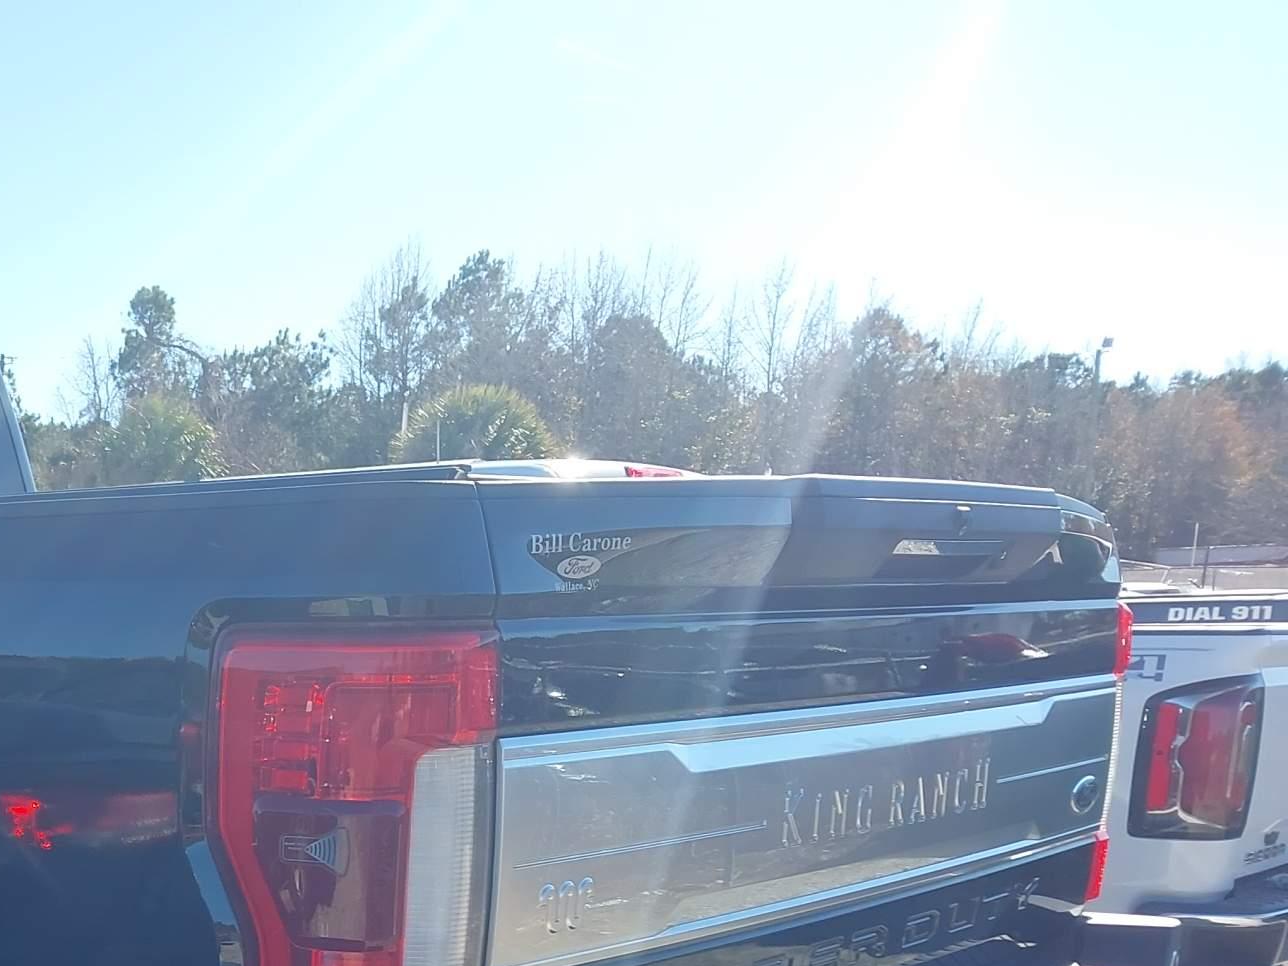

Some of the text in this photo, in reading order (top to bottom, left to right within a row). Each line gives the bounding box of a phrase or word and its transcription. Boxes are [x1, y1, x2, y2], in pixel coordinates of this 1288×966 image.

[530, 532, 632, 554] Bill Carone
[563, 557, 594, 576] Ford
[1167, 605, 1273, 622] DIAL 911
[781, 757, 992, 848] KING RANCH
[901, 876, 1041, 949] DUTY
